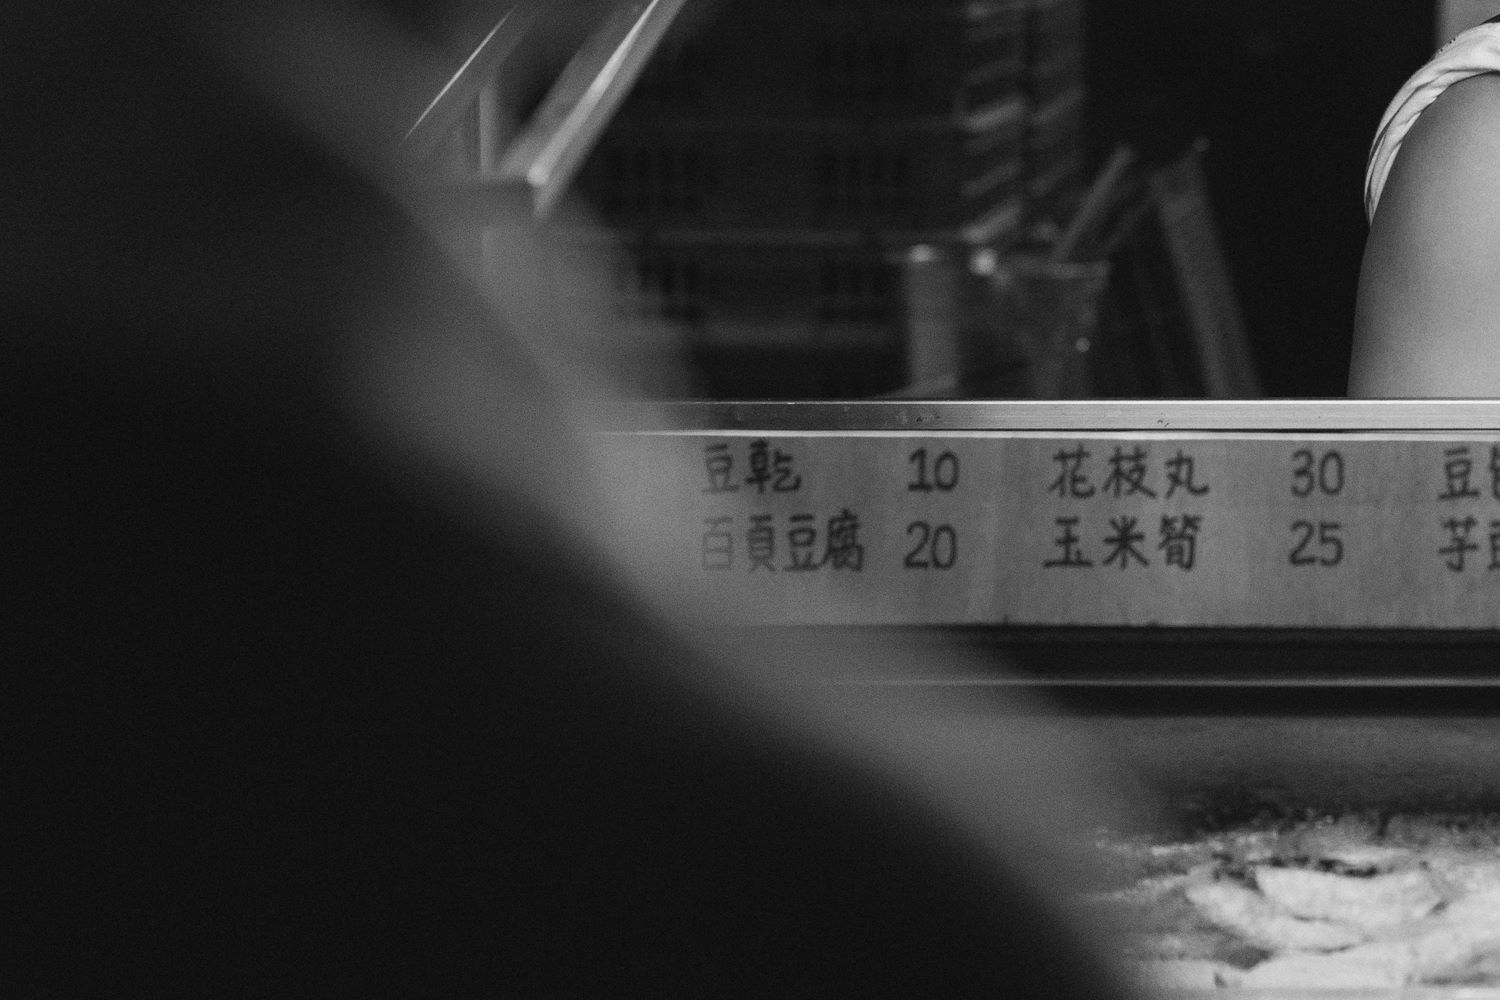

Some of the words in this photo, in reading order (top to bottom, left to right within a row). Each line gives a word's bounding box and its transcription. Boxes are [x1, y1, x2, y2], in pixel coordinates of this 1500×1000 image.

[702, 439, 801, 494] 豆乾
[907, 447, 959, 491] 10
[1049, 444, 1210, 499] 花枝丸
[1291, 449, 1345, 497] 30
[904, 521, 957, 570] 20
[1043, 515, 1202, 571] 玉米筍
[1288, 520, 1343, 567] 25
